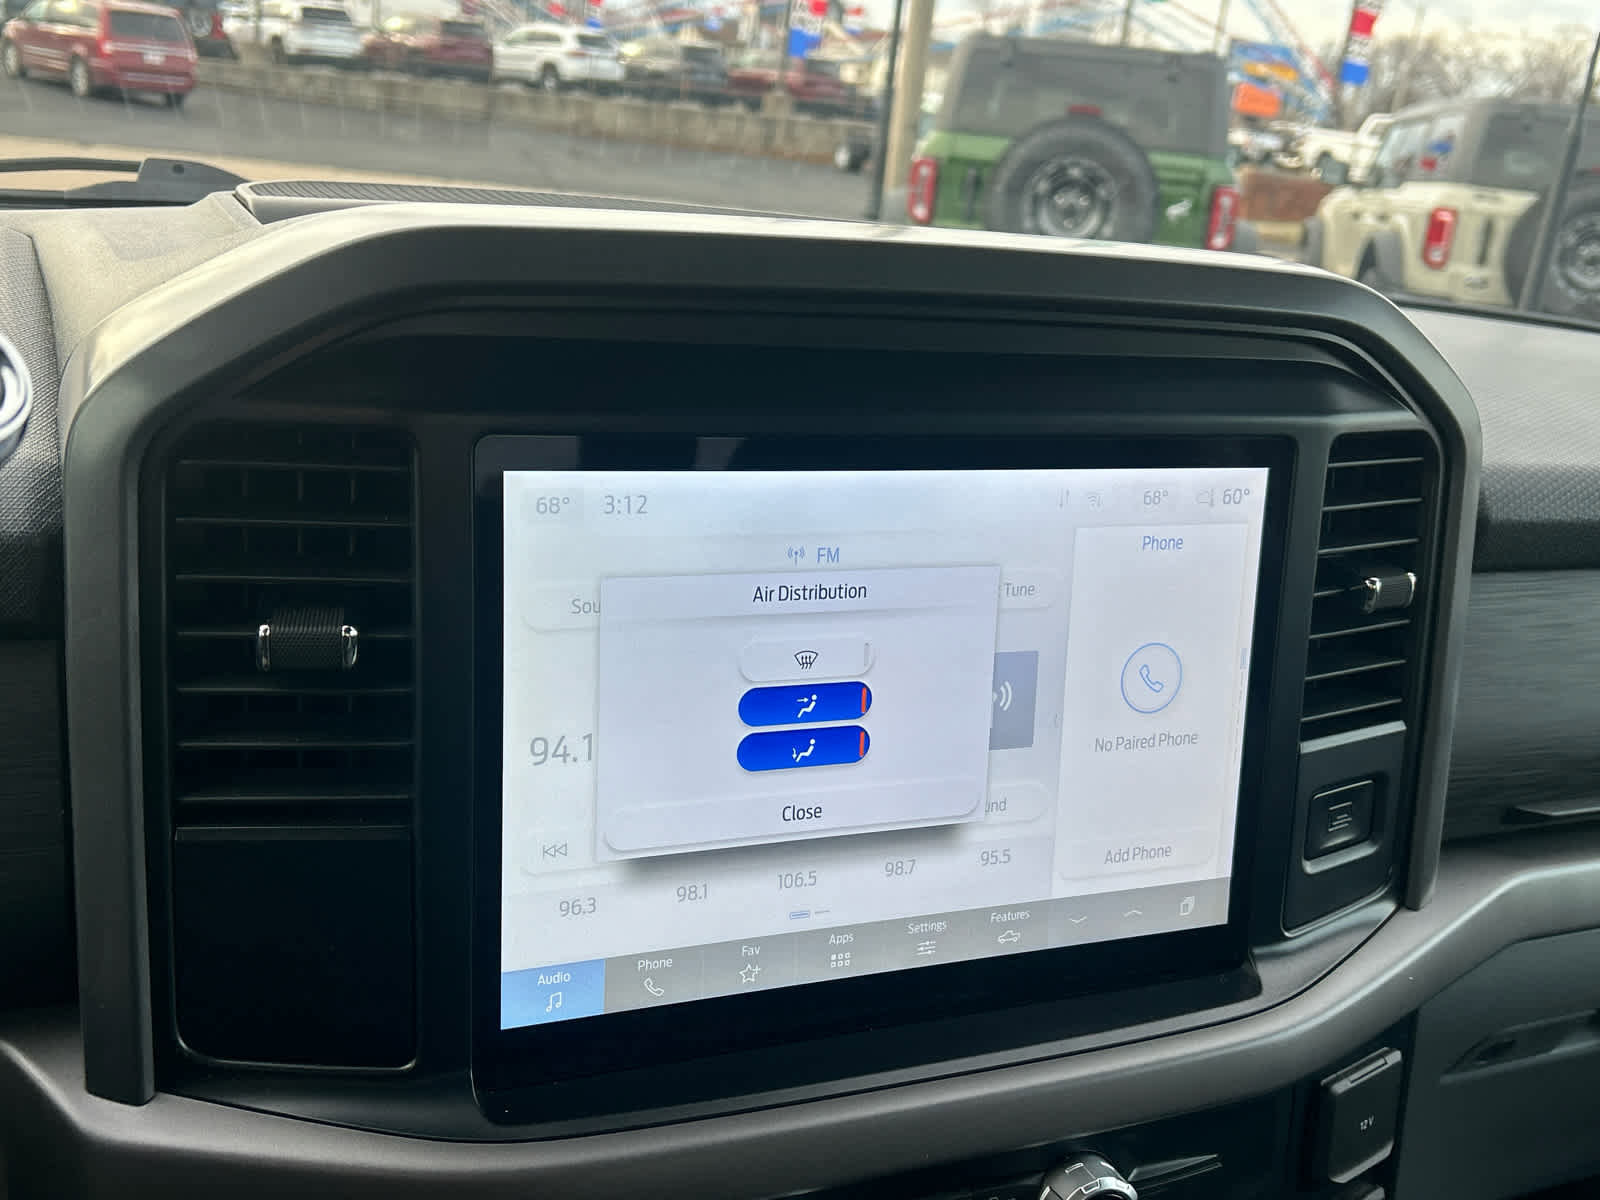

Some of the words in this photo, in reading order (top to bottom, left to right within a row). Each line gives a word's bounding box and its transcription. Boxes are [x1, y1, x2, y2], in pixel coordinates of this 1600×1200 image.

[535, 496, 571, 515] 68°
[603, 494, 649, 516] 3:12
[1143, 490, 1169, 506] 68°
[1222, 488, 1251, 505] 60°
[1142, 535, 1184, 551] Phone
[815, 547, 841, 564] FM
[753, 585, 776, 603] Air
[778, 583, 868, 602] Distribution
[1003, 582, 1036, 598] Tune
[530, 732, 593, 767] 94.1
[1095, 738, 1113, 753] No
[1115, 733, 1156, 752] Paired
[1158, 730, 1199, 748] Phone
[781, 803, 823, 822] Close
[980, 848, 1012, 867] 95.5
[1104, 850, 1130, 865] Add
[1131, 843, 1173, 862] Phone
[884, 858, 916, 878] 98.7
[777, 871, 817, 890] 106.5
[676, 883, 708, 903] 98.1
[559, 897, 597, 918] 96.3
[990, 908, 1031, 923] Features
[907, 919, 948, 935] Settings
[829, 931, 854, 947] Apps
[742, 944, 760, 957] Fav
[637, 956, 673, 972] Phone
[537, 969, 572, 985] Audio
